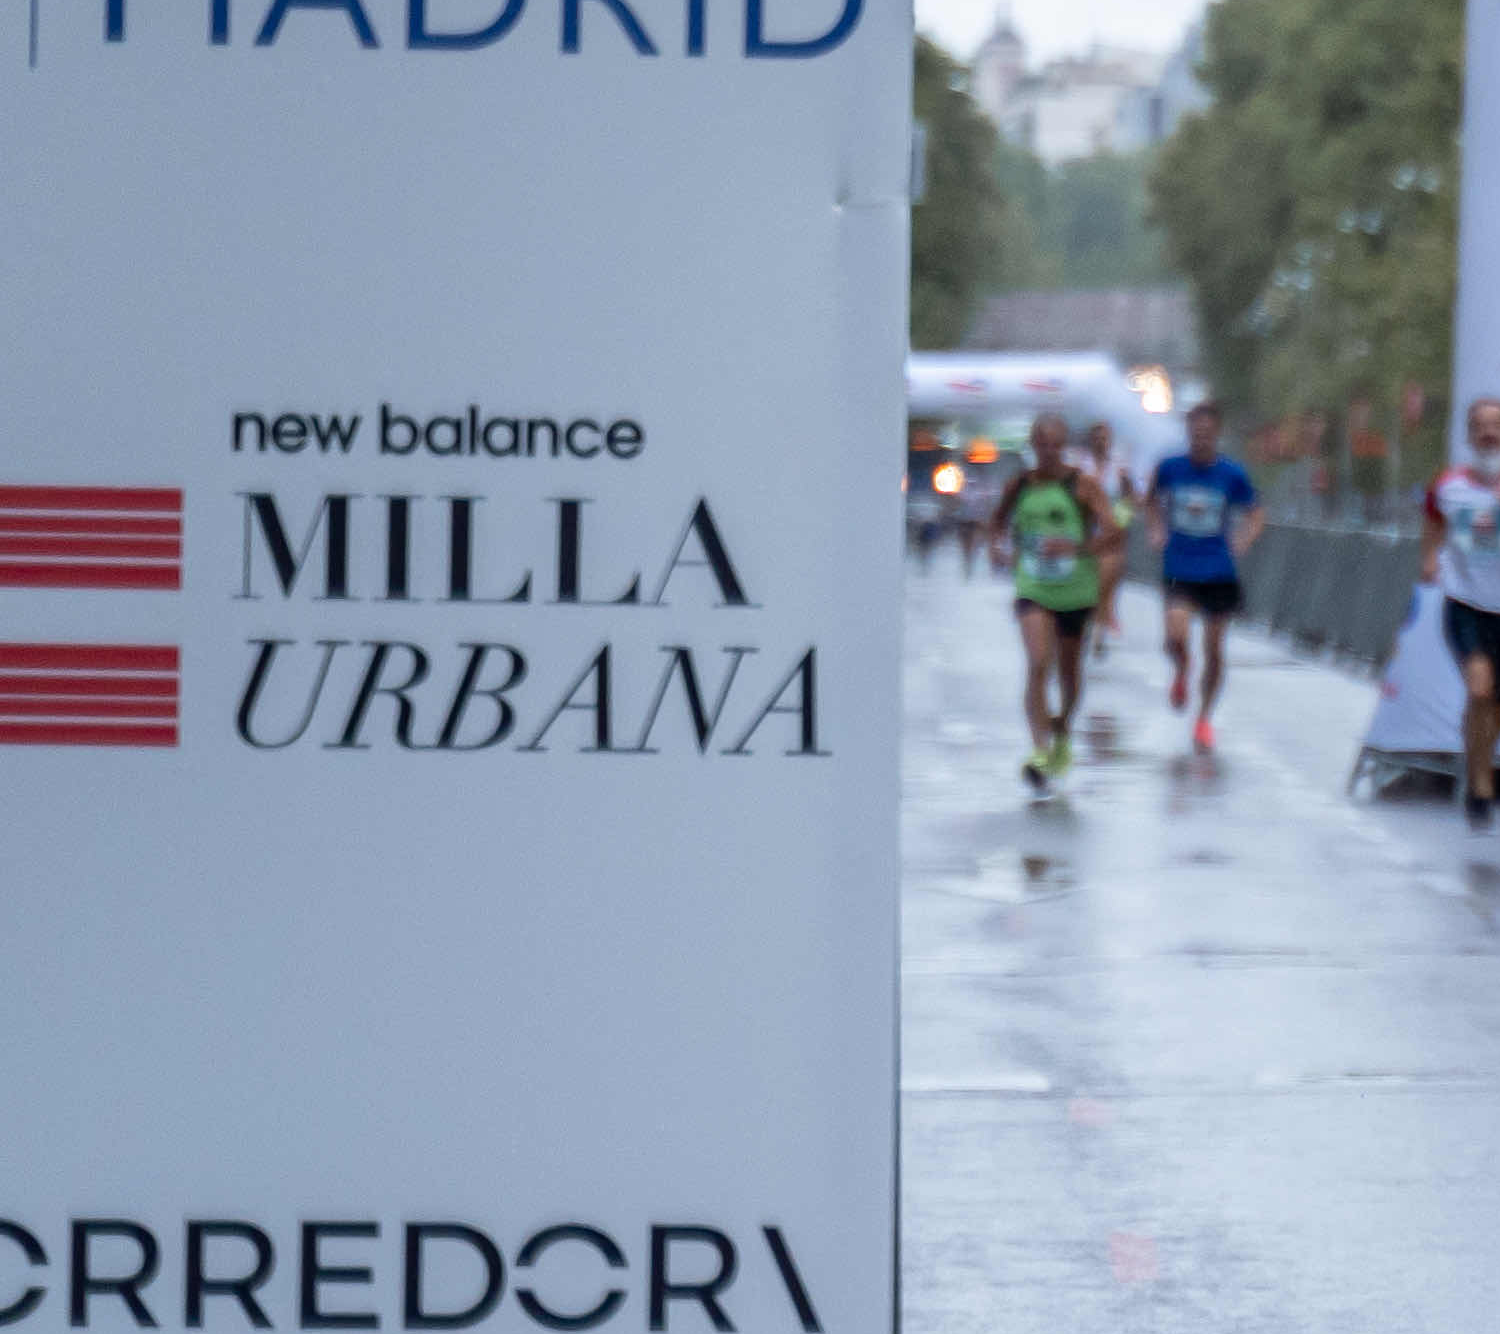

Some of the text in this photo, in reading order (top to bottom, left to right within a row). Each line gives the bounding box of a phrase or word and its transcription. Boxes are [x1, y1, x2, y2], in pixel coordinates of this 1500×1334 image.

[231, 402, 645, 461] new balance
[232, 490, 762, 609] MILLA
[234, 637, 833, 758] URBANA
